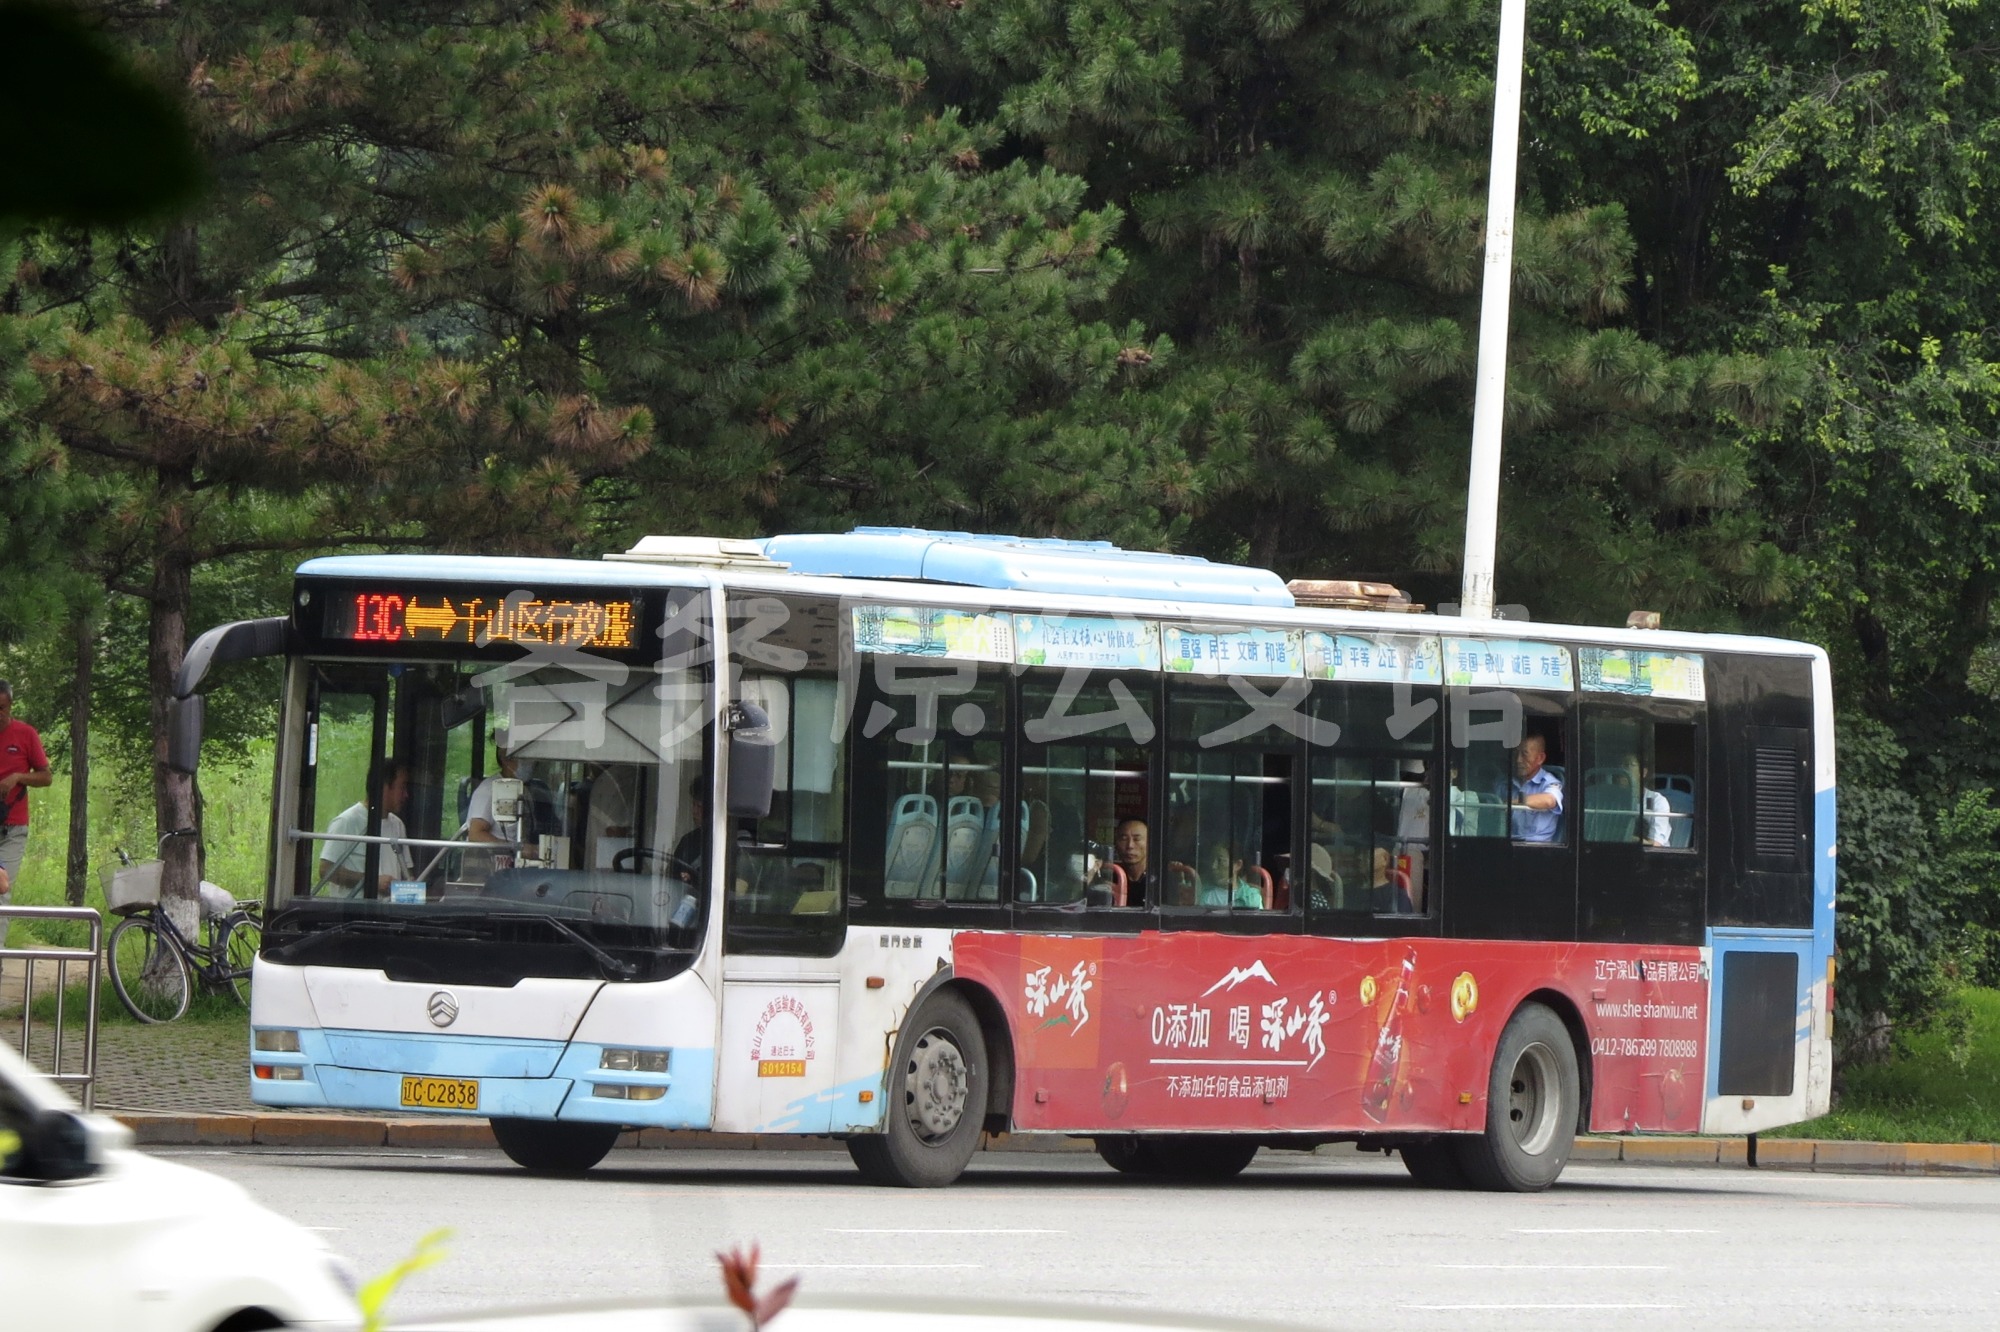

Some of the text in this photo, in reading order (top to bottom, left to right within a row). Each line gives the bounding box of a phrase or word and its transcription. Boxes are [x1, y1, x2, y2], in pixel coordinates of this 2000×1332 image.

[353, 594, 403, 641] 13C
[1180, 638, 1286, 663] 富强 民主 文明 和谐
[1323, 646, 1343, 666] 自由
[1350, 647, 1370, 668] 平等
[1377, 647, 1397, 669] 公正
[1458, 652, 1560, 677] 爱国 敬业 诚信 友善
[1595, 959, 1699, 982] 辽宁深山品有限公司
[1151, 1003, 1211, 1049] 0添加
[1228, 1005, 1250, 1049] 喝
[1659, 1038, 1697, 1058] 7808988
[761, 1062, 803, 1075] 6012154
[1166, 1075, 1289, 1098] 不添加任何食品添加剂
